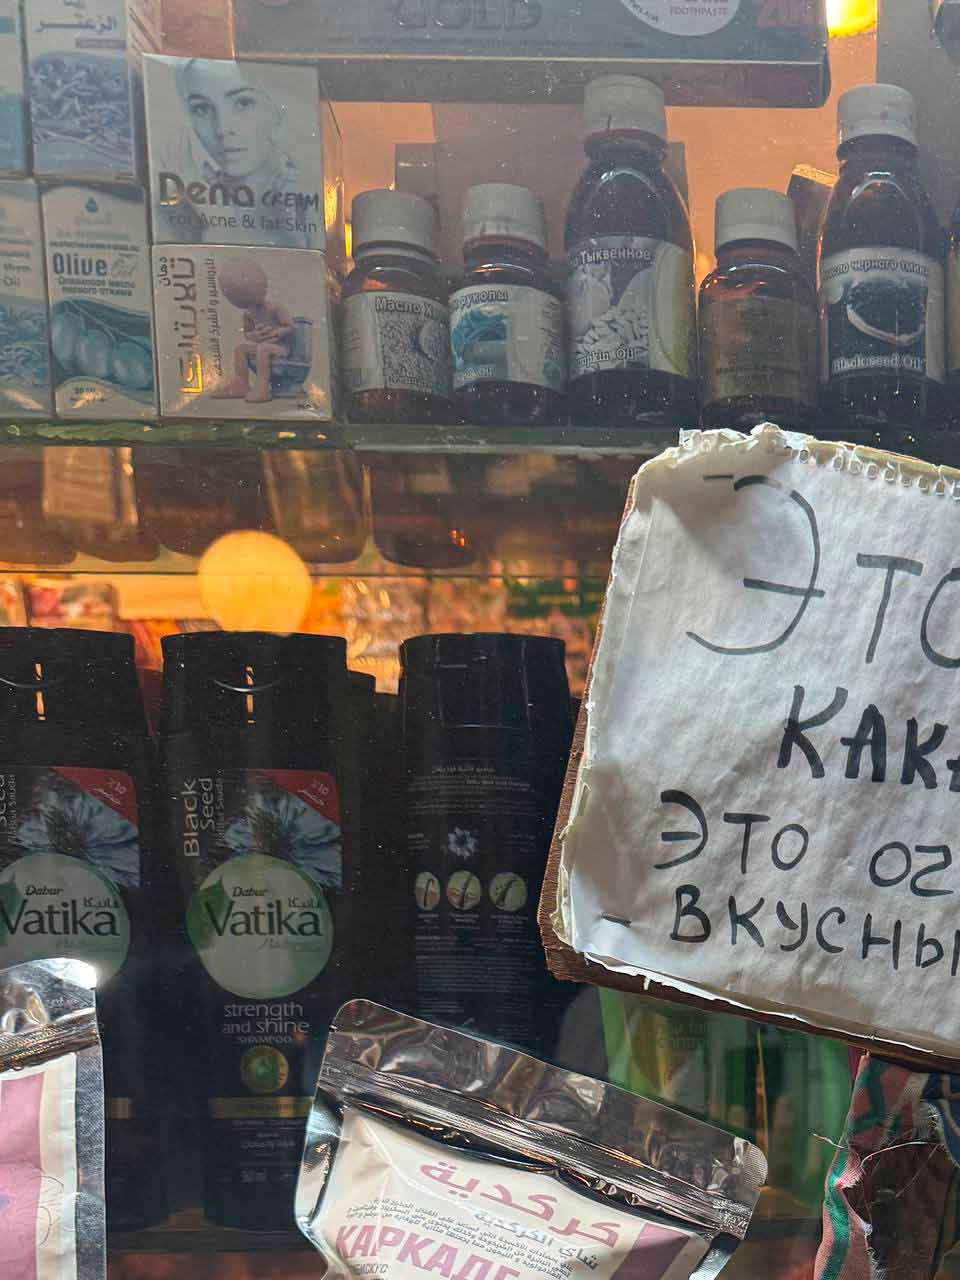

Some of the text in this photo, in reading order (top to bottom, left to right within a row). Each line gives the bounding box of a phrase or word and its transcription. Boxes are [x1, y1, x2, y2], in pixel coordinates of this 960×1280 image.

[159, 172, 255, 208] Dena
[200, 213, 237, 228] Acne
[242, 213, 256, 229] &
[286, 217, 318, 233] Skin
[53, 252, 107, 276] Olive
[375, 296, 420, 314] Масло
[200, 778, 214, 830] Seed
[181, 778, 200, 857] Black
[654, 788, 810, 873] ЭТО
[24, 884, 64, 896] Dabur
[232, 886, 269, 897] Dabur
[0, 897, 121, 936] Vatika
[204, 900, 323, 937] Vatika
[223, 1001, 304, 1020] strength
[222, 1020, 310, 1034] and shine
